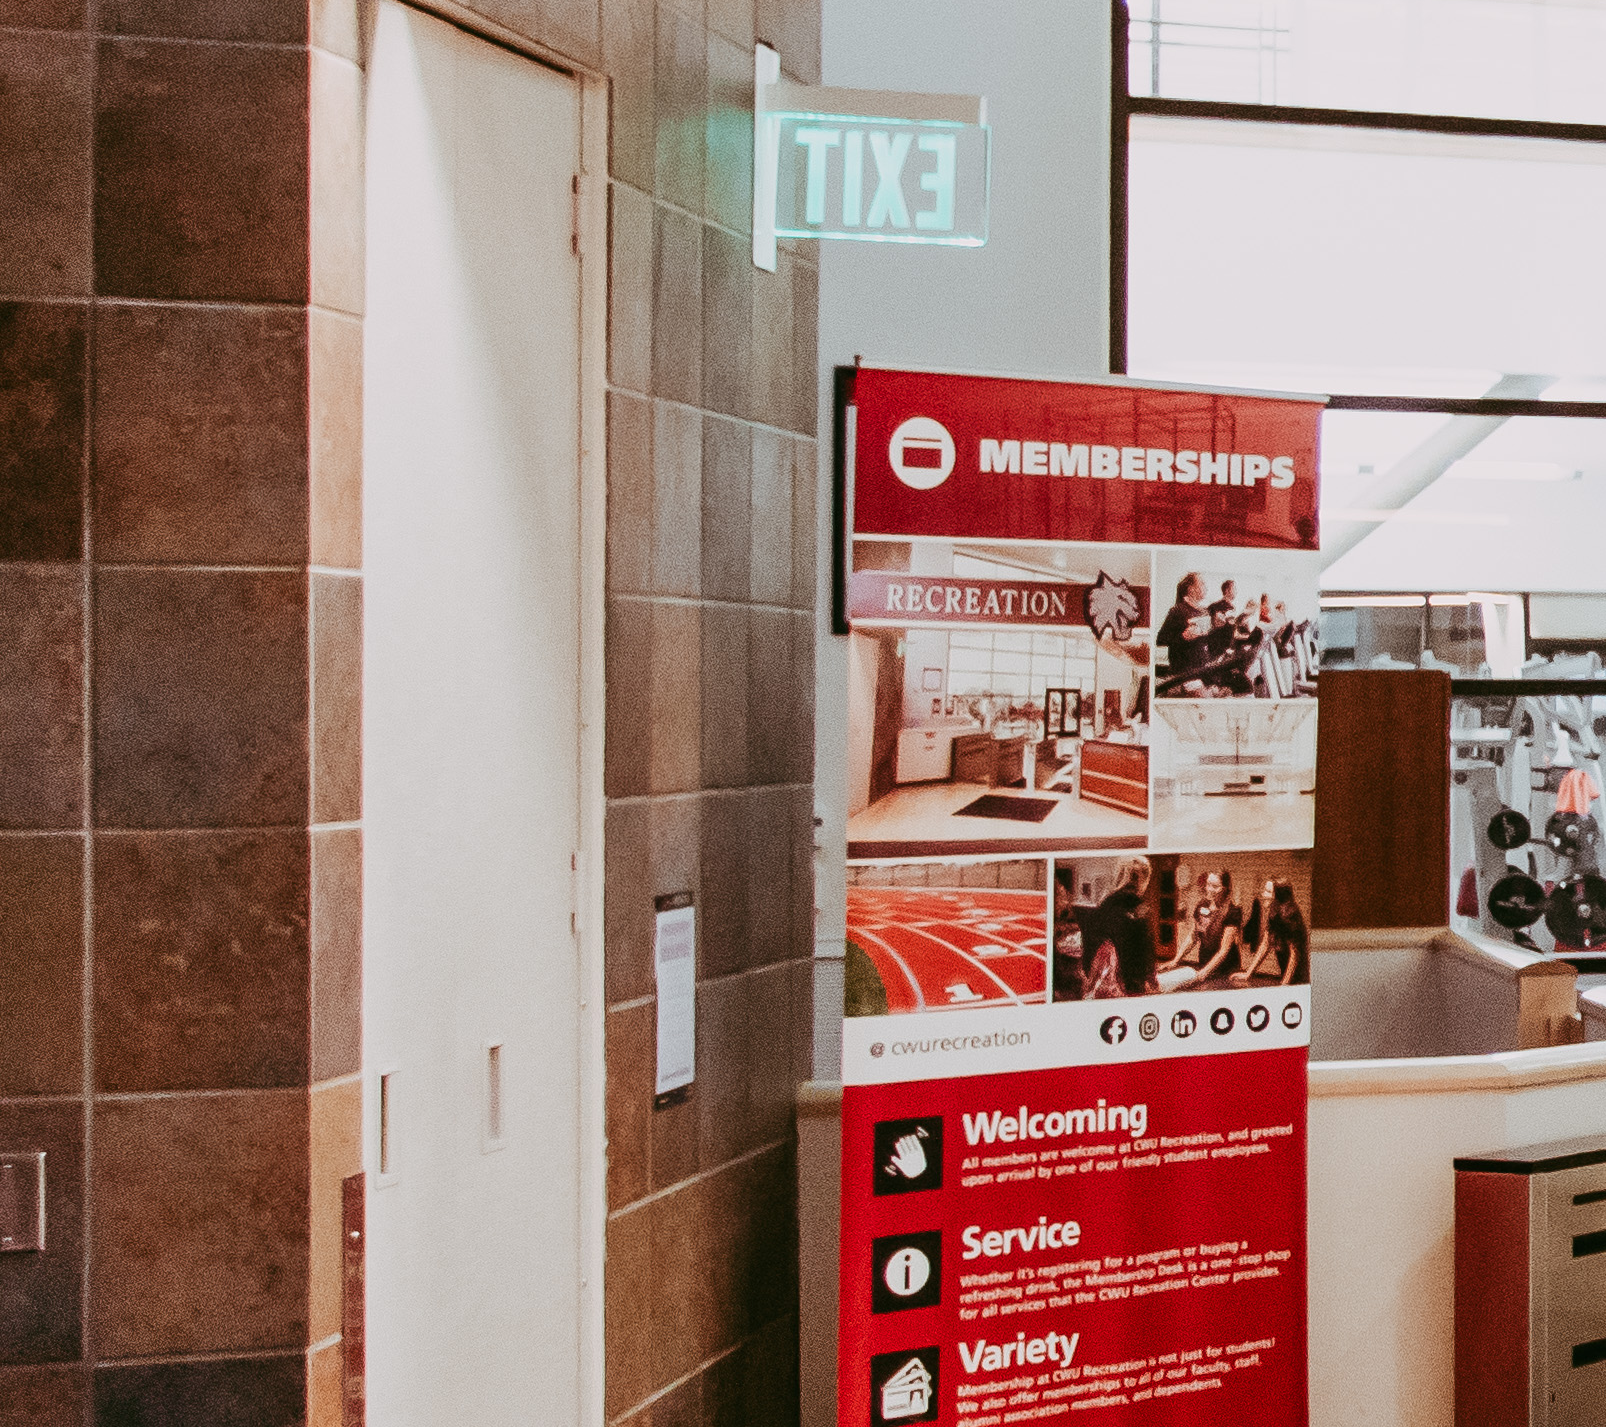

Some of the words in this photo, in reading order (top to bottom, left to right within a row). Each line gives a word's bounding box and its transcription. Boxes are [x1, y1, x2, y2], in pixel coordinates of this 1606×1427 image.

[978, 438, 1296, 490] MEMBERSHIPS
[885, 583, 1068, 618] RECREATION
[891, 1028, 1031, 1056] cwurecreation
[962, 1099, 1148, 1147] Welcoming
[962, 1157, 979, 1170] All
[982, 1151, 1037, 1167] members
[1040, 1149, 1058, 1162] are
[1061, 1144, 1115, 1159] welcome
[1118, 1142, 1130, 1154] at
[1134, 1137, 1158, 1151] CWU
[1228, 1128, 1248, 1142] and
[1250, 1123, 1293, 1141] greeted
[961, 1172, 993, 1188] upon
[996, 1167, 1035, 1183] arrival
[1038, 1165, 1052, 1181] by
[1054, 1163, 1076, 1176] one
[1079, 1159, 1093, 1173] of
[1095, 1159, 1119, 1171] our
[1122, 1152, 1161, 1169] friendly
[1163, 1147, 1208, 1163] student
[962, 1217, 1080, 1260] Service
[959, 1286, 1023, 1304] refreshing
[1063, 1277, 1082, 1289] the
[1085, 1267, 1155, 1286] Membership
[1158, 1262, 1184, 1276] Desk
[1187, 1261, 1197, 1272] is
[1200, 1260, 1208, 1270] a
[1264, 1249, 1291, 1262] shop
[960, 1271, 1013, 1288] Whether
[1037, 1260, 1101, 1278] registering
[1104, 1256, 1123, 1268] for
[1126, 1255, 1134, 1265] a
[1136, 1248, 1180, 1266] program
[1183, 1246, 1197, 1257] or
[1199, 1241, 1239, 1256] buying
[1241, 1240, 1249, 1249] a
[959, 1308, 978, 1321] for
[981, 1304, 998, 1318] all
[1001, 1299, 1046, 1315] services
[1049, 1294, 1072, 1308] that
[1075, 1292, 1095, 1304] the
[1099, 1287, 1130, 1302] CWU
[1132, 1278, 1188, 1296] Recreation
[1191, 1273, 1230, 1287] Center
[957, 1376, 1034, 1397] Membership
[1037, 1373, 1050, 1385] at
[1053, 1367, 1080, 1382] CWU
[1083, 1358, 1146, 1377] Recreation
[1148, 1356, 1156, 1367] is
[1158, 1352, 1177, 1365] not
[1180, 1348, 1203, 1364] just
[1206, 1345, 1223, 1358] for
[958, 1331, 1079, 1374] Variety
[957, 1400, 979, 1414] We
[982, 1397, 1006, 1411] also
[1009, 1391, 1039, 1405] offer
[1042, 1377, 1120, 1400] memberships
[1123, 1376, 1136, 1388] to
[1138, 1372, 1151, 1385] all
[1153, 1369, 1165, 1382] of
[1166, 1367, 1187, 1379] our
[1004, 1403, 1068, 1423] association
[1132, 1389, 1152, 1402] and
